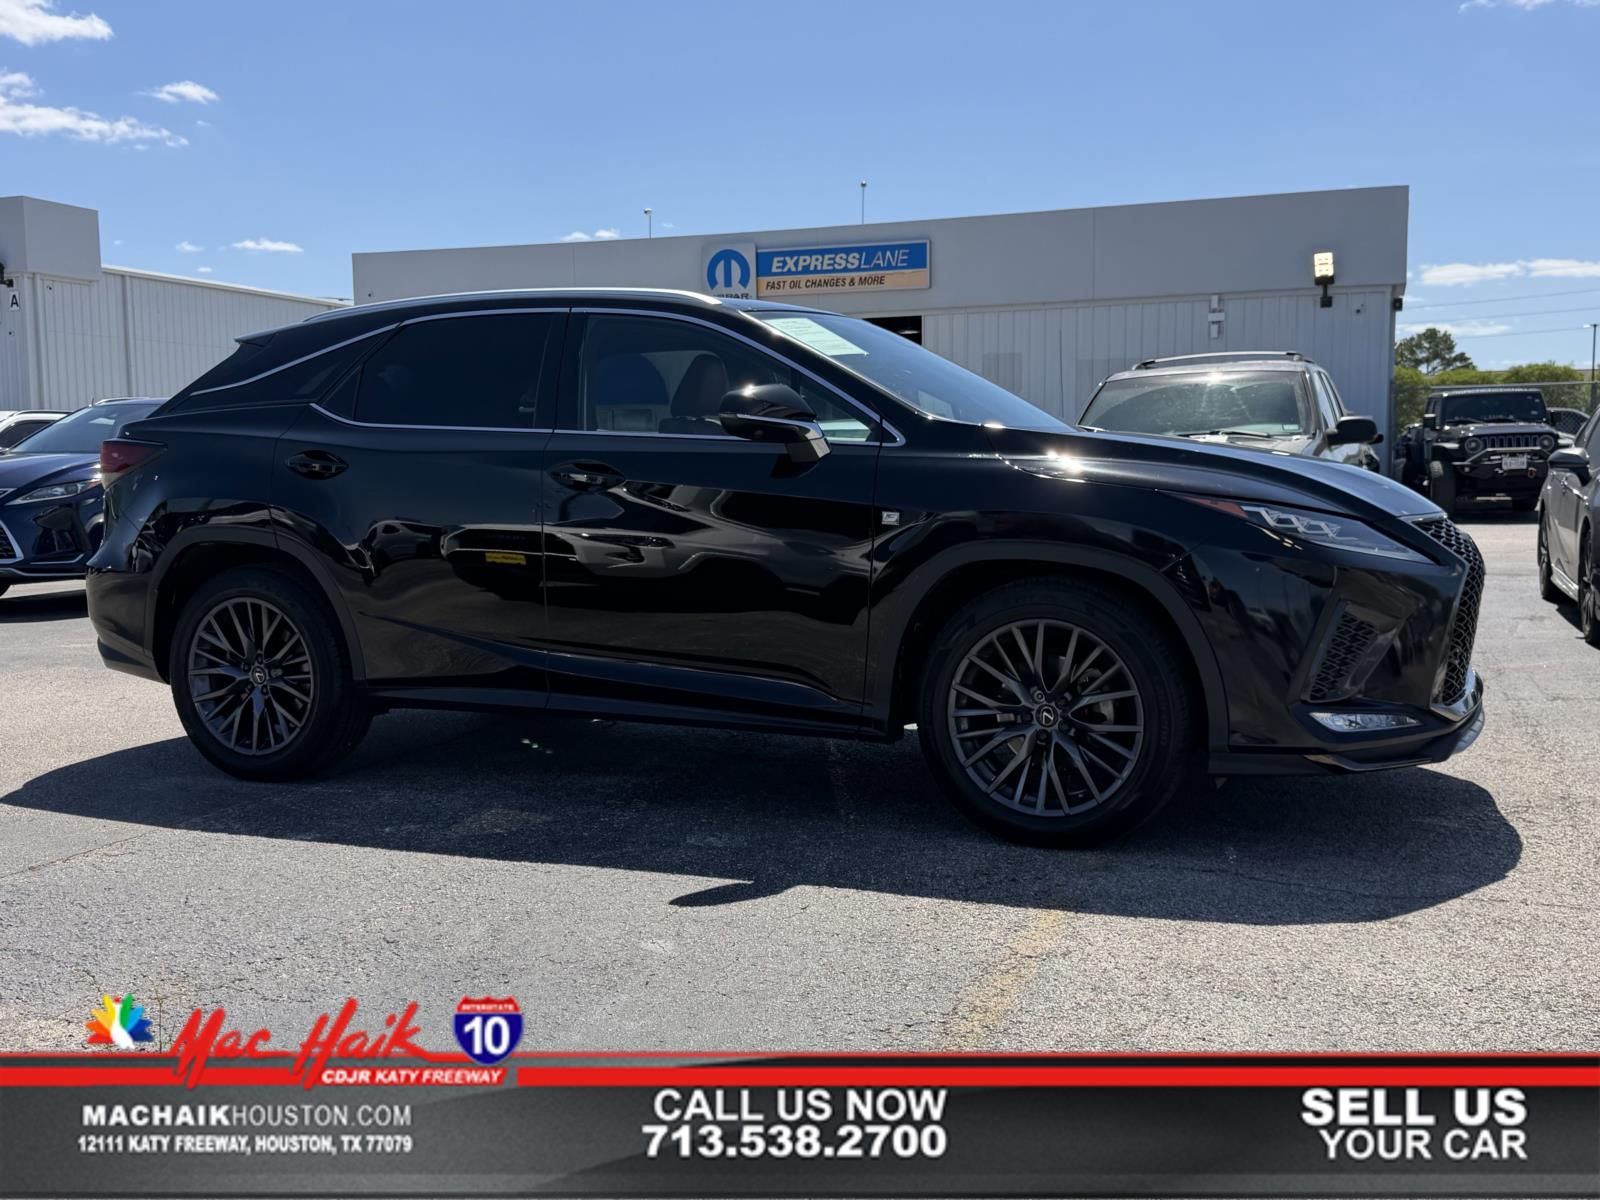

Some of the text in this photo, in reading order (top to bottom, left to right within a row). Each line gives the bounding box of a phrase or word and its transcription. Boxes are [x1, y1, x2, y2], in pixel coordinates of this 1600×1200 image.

[771, 249, 910, 273] EXPRESSLANE
[765, 275, 886, 291] FAST OIL CHANGES & MORE
[10, 294, 19, 308] A
